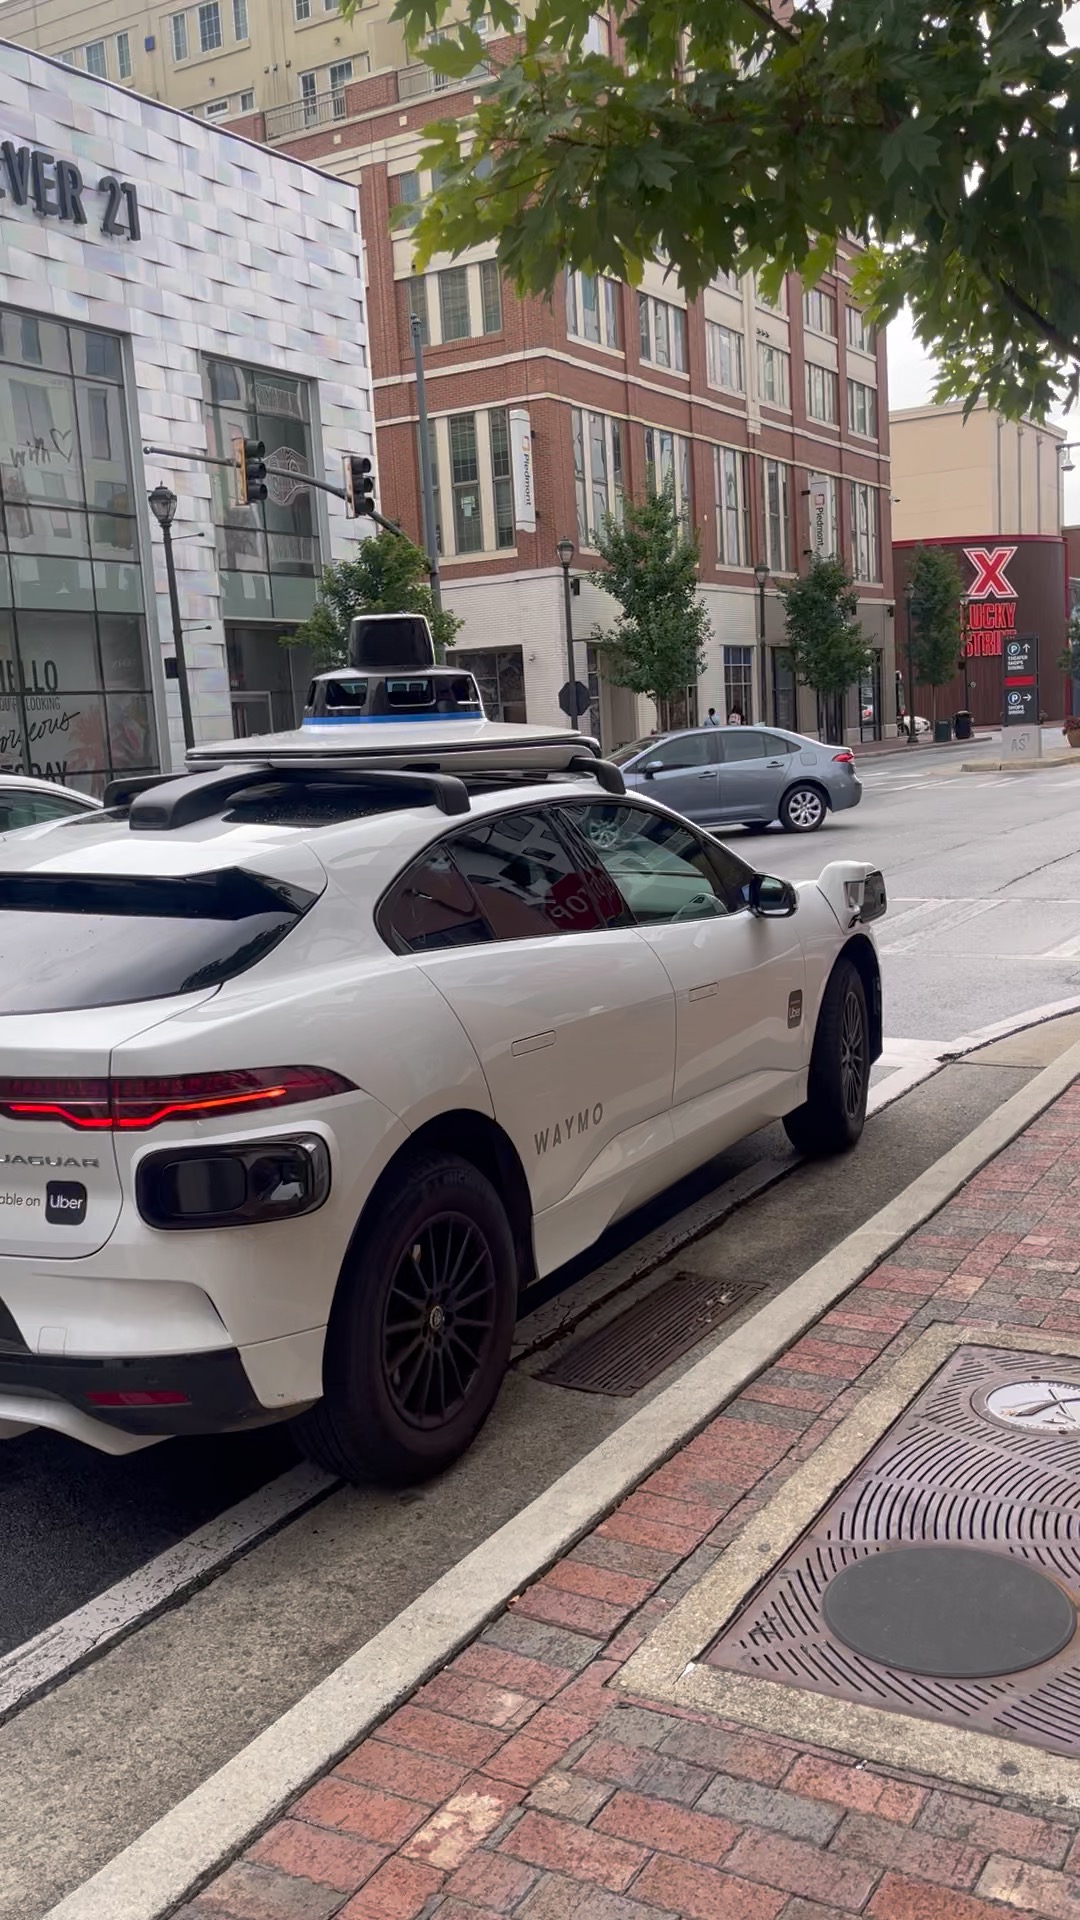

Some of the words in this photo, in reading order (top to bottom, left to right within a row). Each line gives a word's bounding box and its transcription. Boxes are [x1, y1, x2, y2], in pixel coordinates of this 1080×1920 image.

[0, 141, 87, 224] VER
[98, 175, 141, 241] 21
[523, 453, 532, 506] Piedmont
[815, 507, 825, 546] Piedmont
[960, 629, 1017, 657] STRI
[25, 696, 60, 711] LOOKING
[0, 711, 80, 757] oreous
[534, 1102, 603, 1155] WAYMO
[0, 1154, 100, 1169] JAGUAR
[25, 1196, 41, 1207] on
[50, 1194, 83, 1209] Uber
